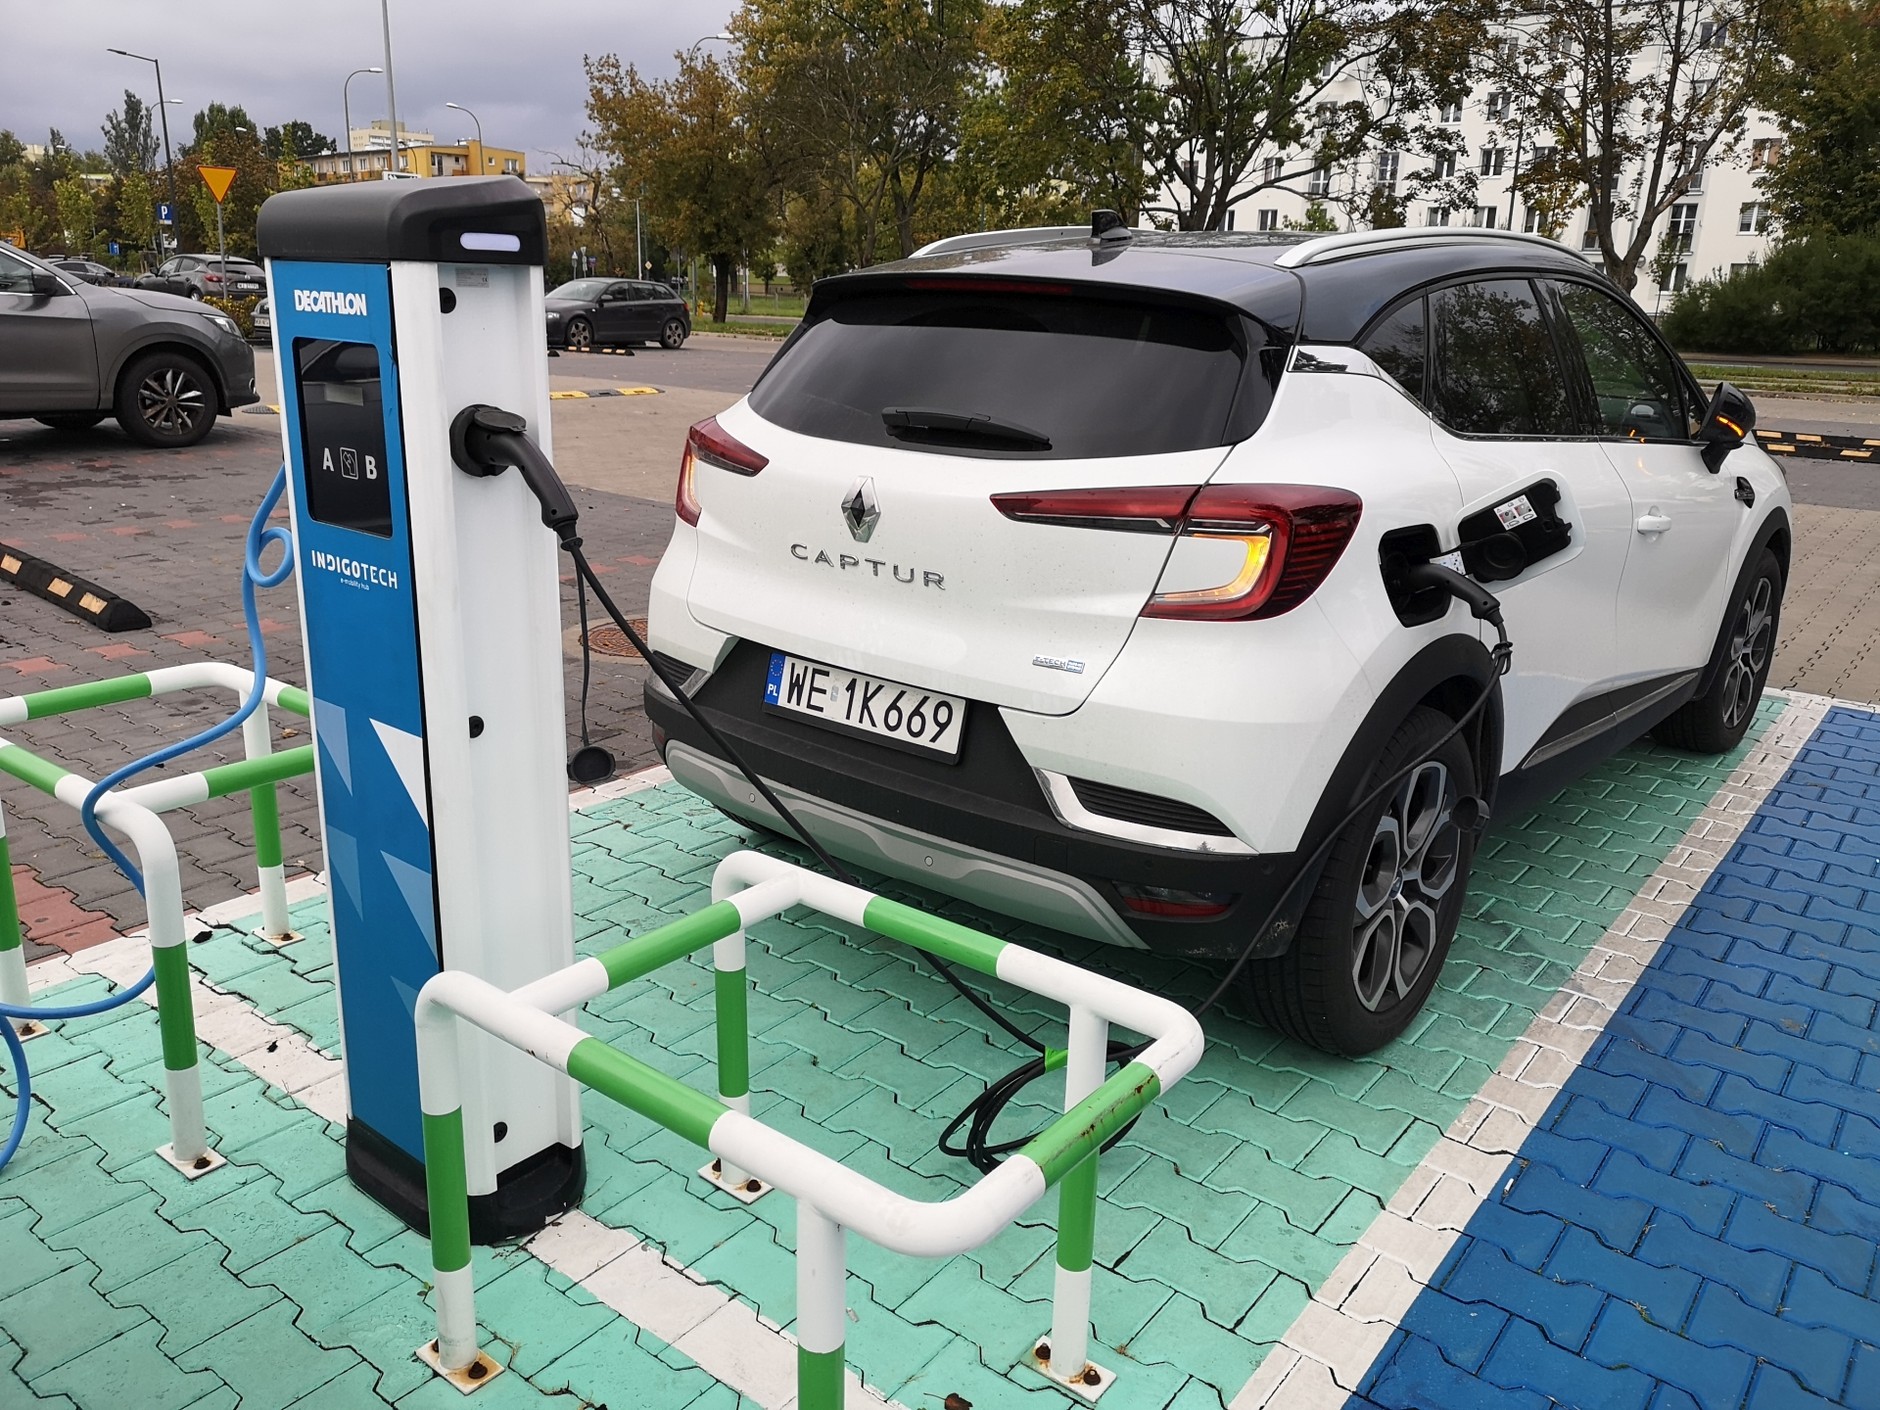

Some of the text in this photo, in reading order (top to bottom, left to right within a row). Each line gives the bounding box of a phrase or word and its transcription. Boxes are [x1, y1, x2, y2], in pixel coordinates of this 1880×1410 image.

[161, 205, 168, 219] P
[294, 289, 367, 316] DECATHLON
[322, 447, 334, 472] A
[365, 455, 378, 480] B
[311, 550, 398, 590] INDIGOTECH
[790, 542, 946, 591] CAPTUR
[361, 582, 370, 591] hub
[767, 683, 778, 697] PL
[786, 662, 954, 743] WE 1K669
